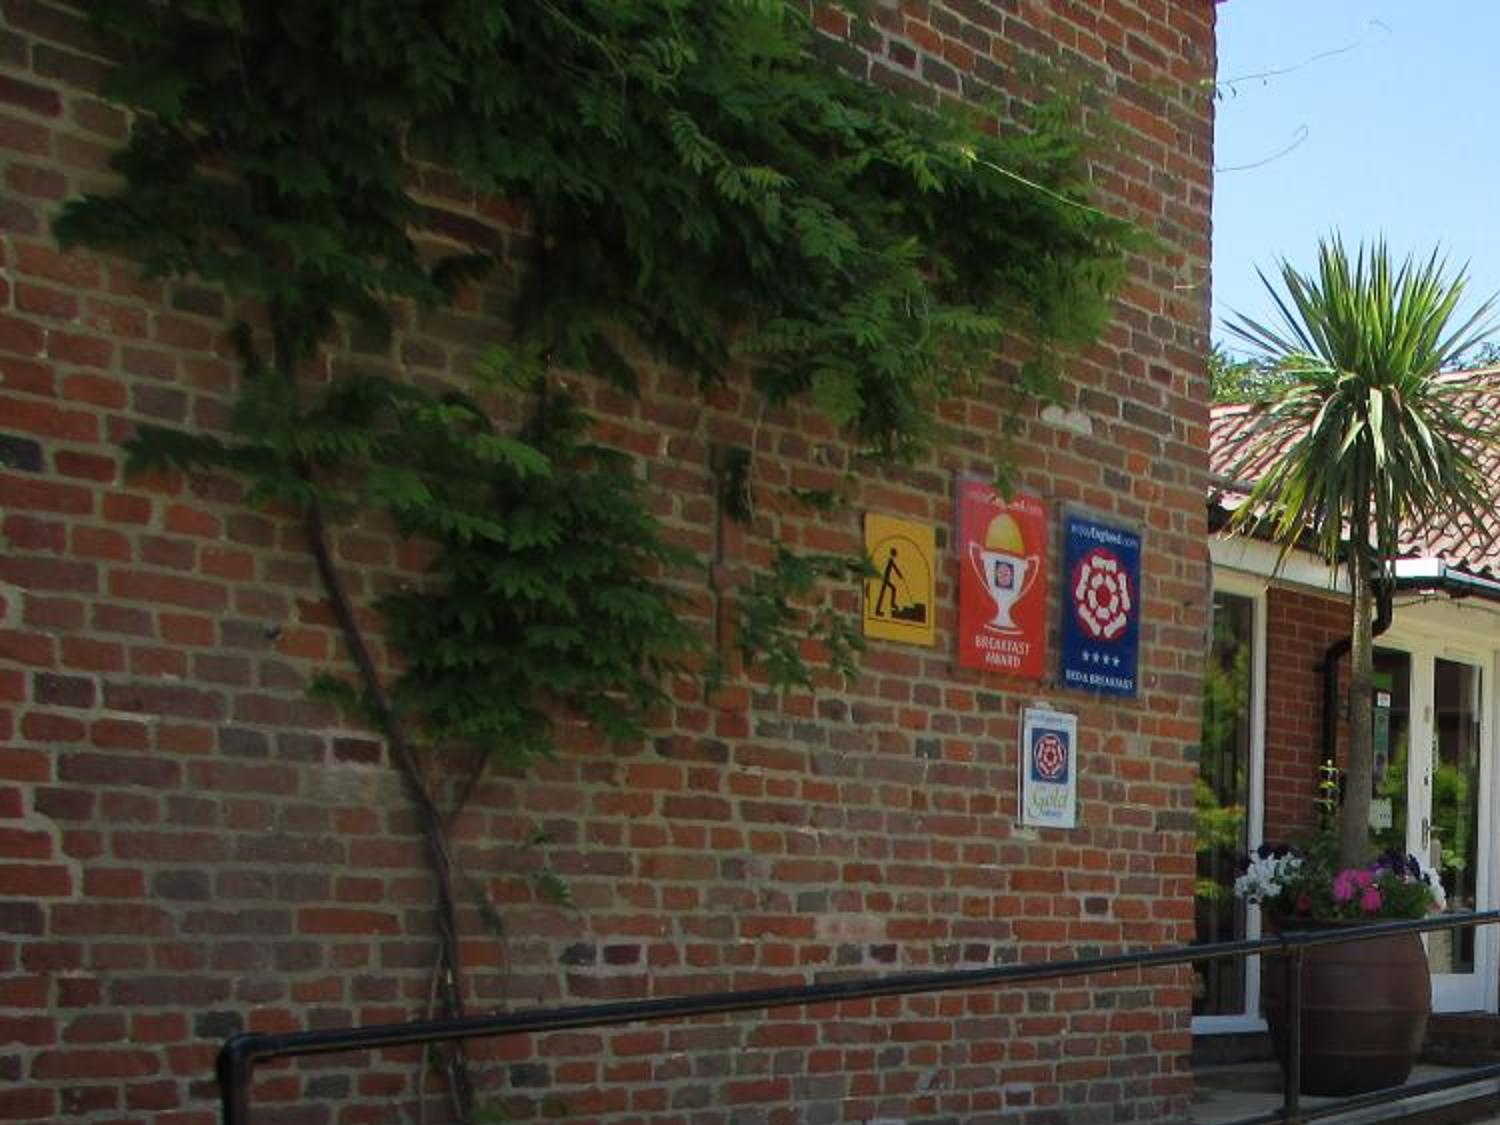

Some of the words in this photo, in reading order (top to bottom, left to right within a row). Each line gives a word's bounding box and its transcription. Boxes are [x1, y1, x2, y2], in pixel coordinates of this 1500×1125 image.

[975, 634, 1030, 656] BREAKFAST
[985, 651, 1021, 668] AWARD
[1065, 669, 1083, 682] BED
[1089, 673, 1133, 690] BREAKFAST
